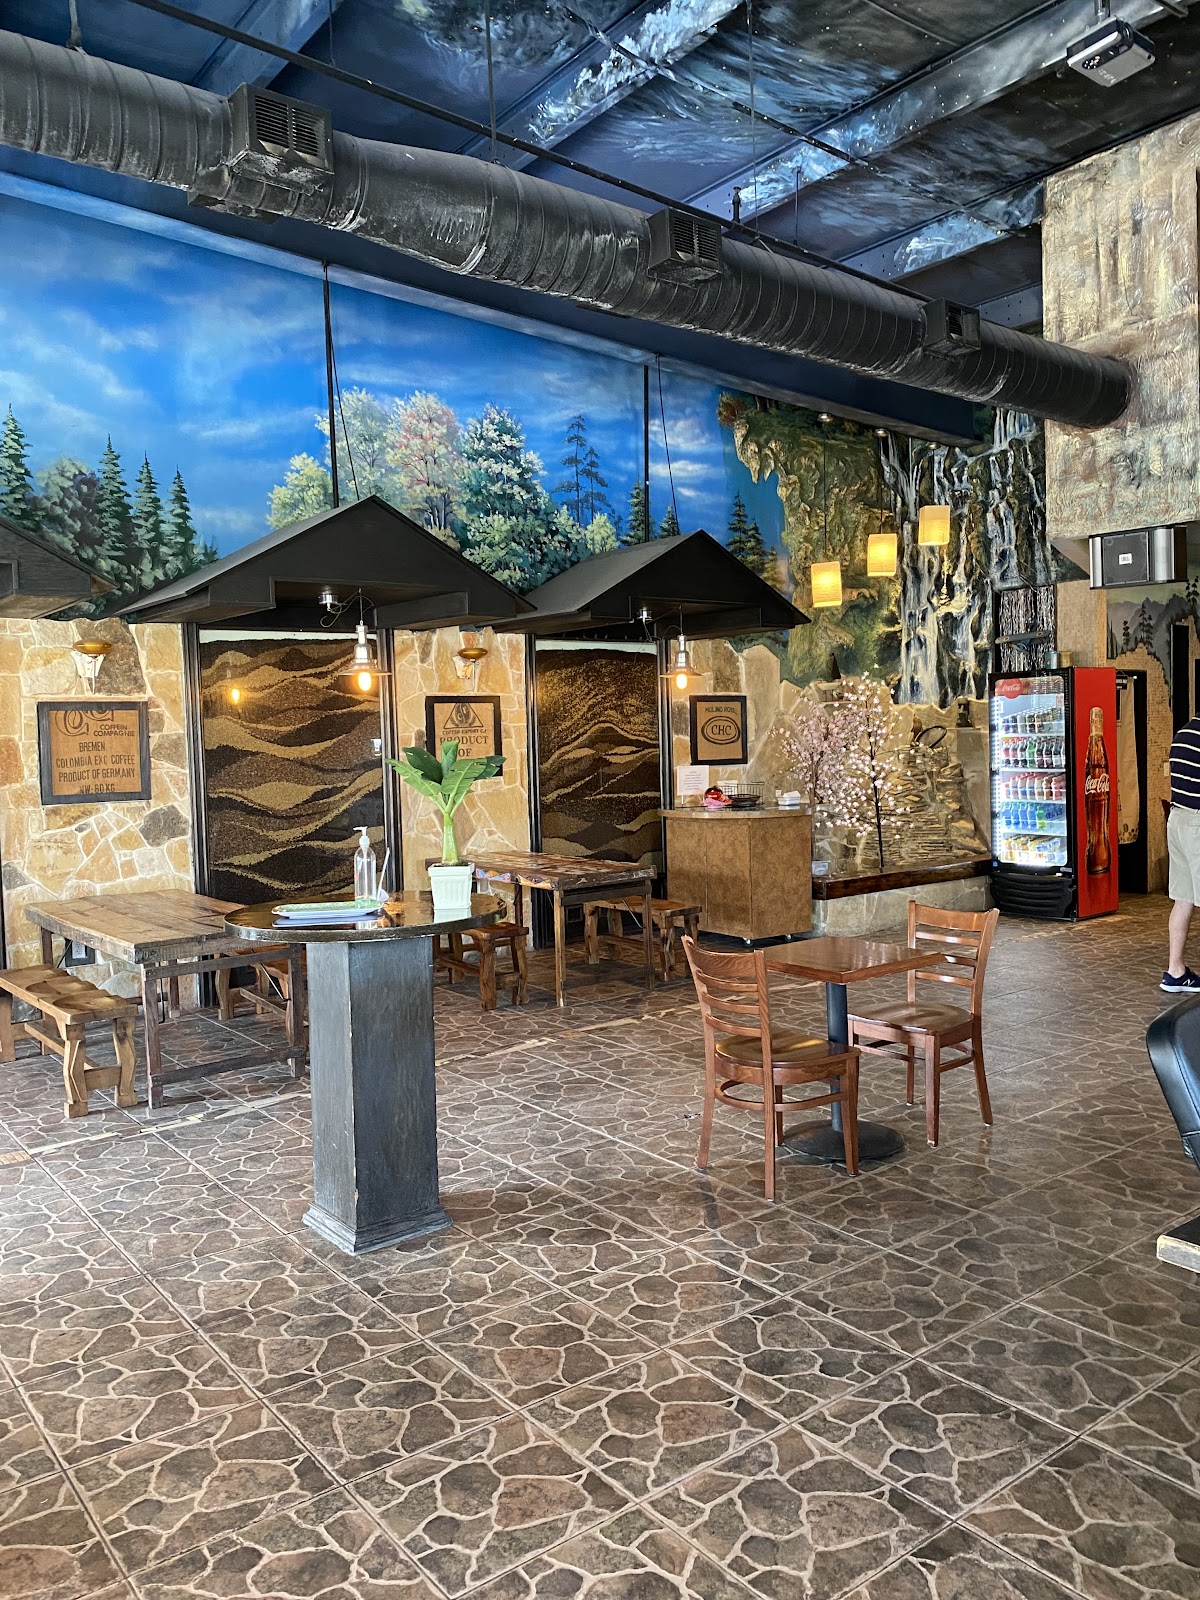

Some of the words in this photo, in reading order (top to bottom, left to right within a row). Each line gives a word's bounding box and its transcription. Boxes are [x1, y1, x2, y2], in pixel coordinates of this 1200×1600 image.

[1002, 683, 1021, 692] Coca-Cola
[711, 724, 732, 736] CHC
[79, 742, 105, 752] BREMEN
[458, 748, 472, 757] OF
[56, 755, 92, 769] COLOMBIA
[111, 754, 135, 765] COFFEE
[58, 769, 90, 783] PRODUCT
[91, 769, 101, 779] OF
[101, 767, 135, 779] GERMANY
[1084, 773, 1110, 795] Coca-Cola
